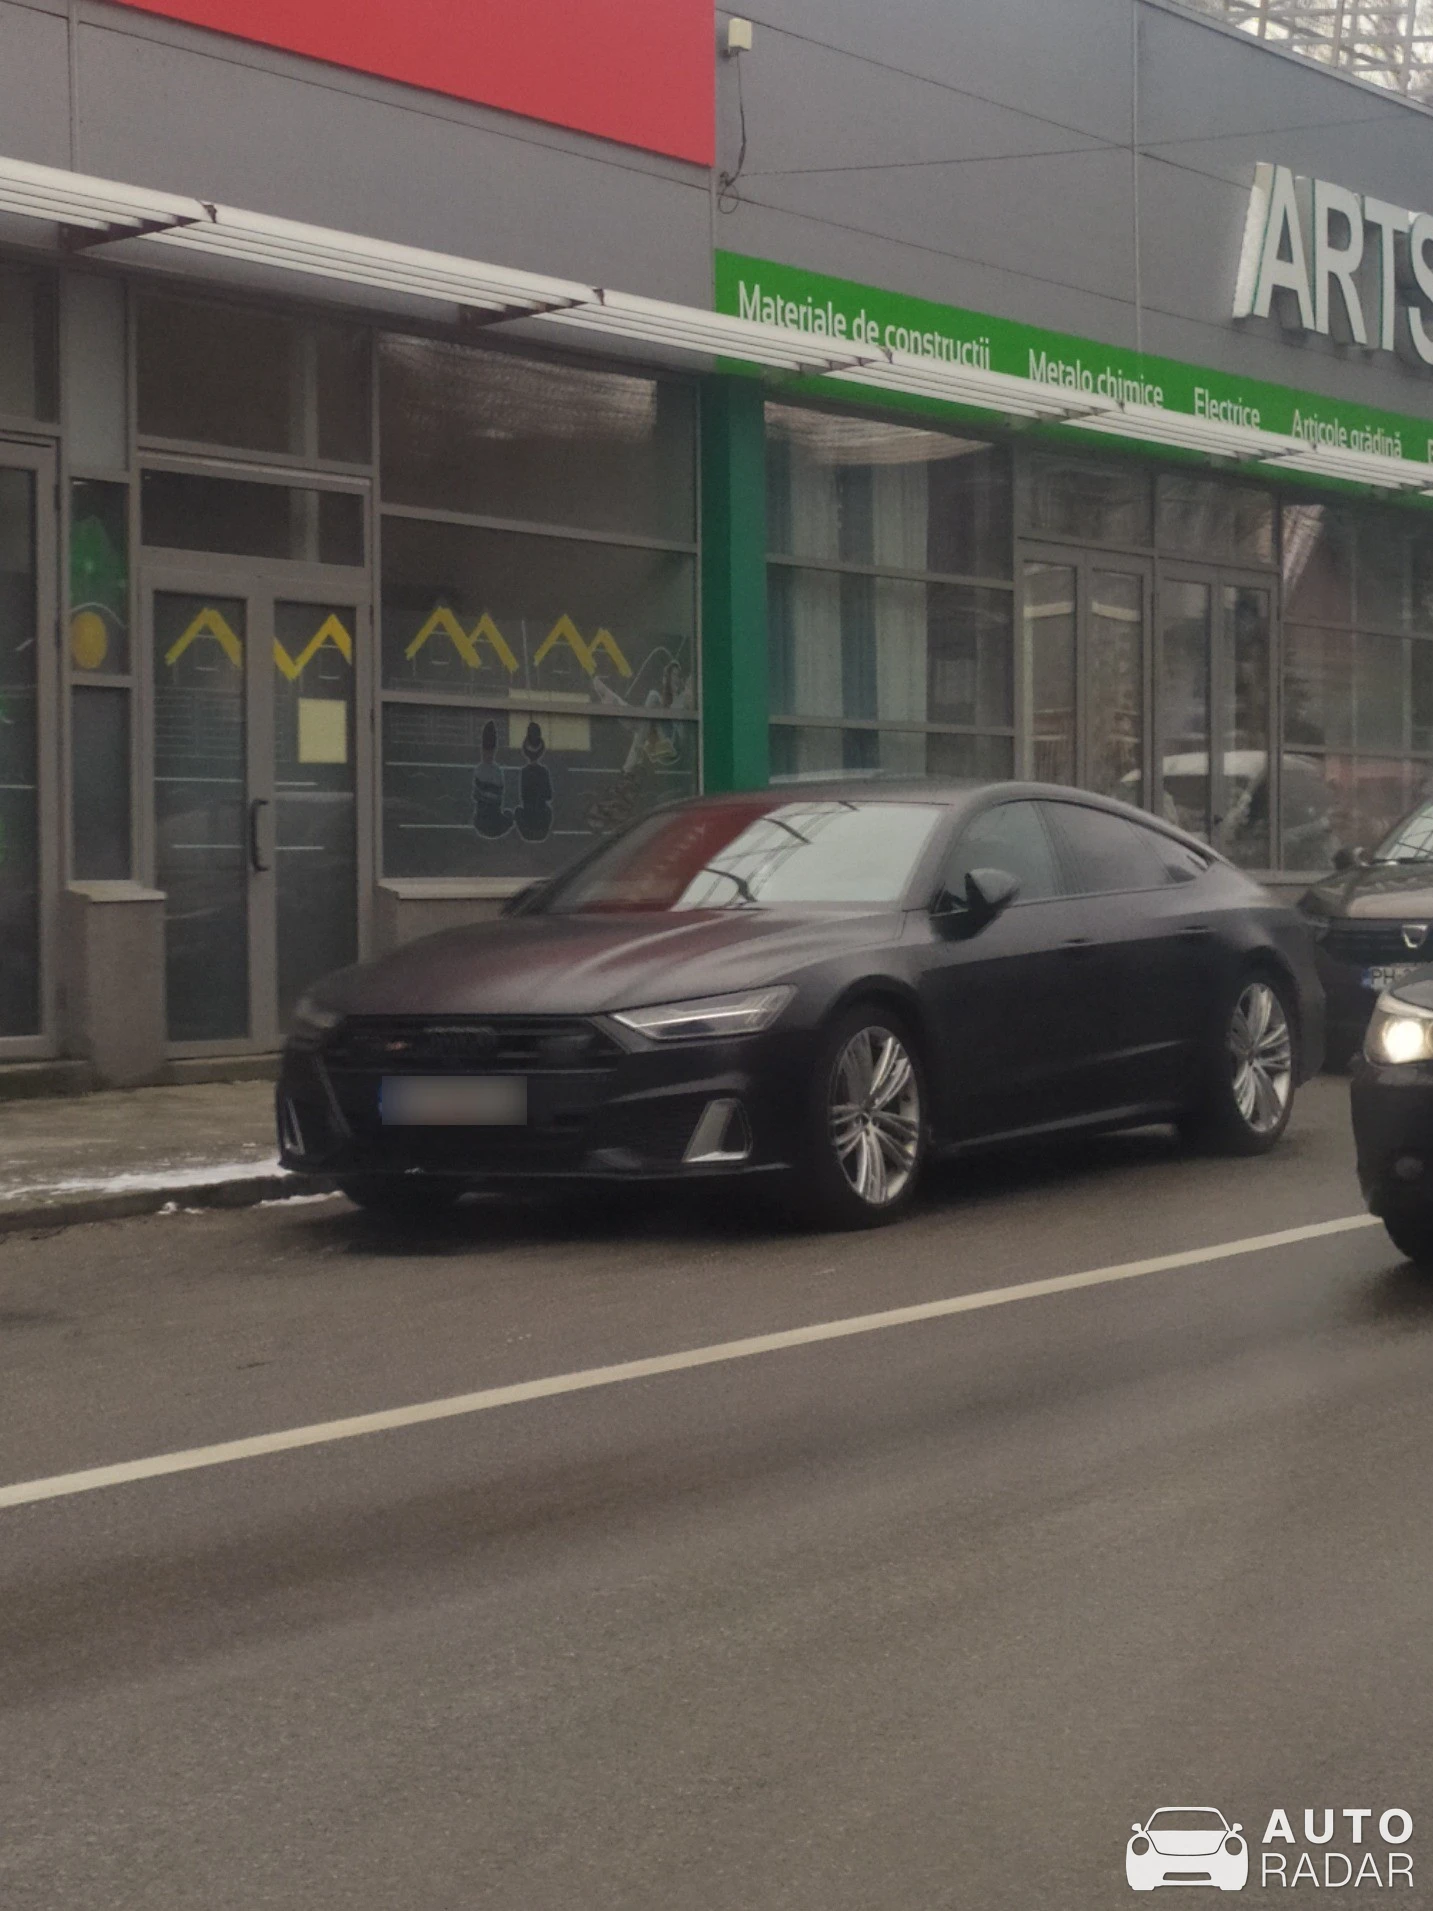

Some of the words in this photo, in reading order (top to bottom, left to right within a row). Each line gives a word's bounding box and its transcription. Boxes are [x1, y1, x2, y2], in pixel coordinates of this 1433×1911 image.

[738, 280, 847, 340] Materiale
[852, 308, 880, 346] de
[1028, 351, 1093, 392] Metalo
[1097, 366, 1164, 408] chimice
[1194, 386, 1260, 431] Electrice
[1292, 408, 1348, 448] Articole
